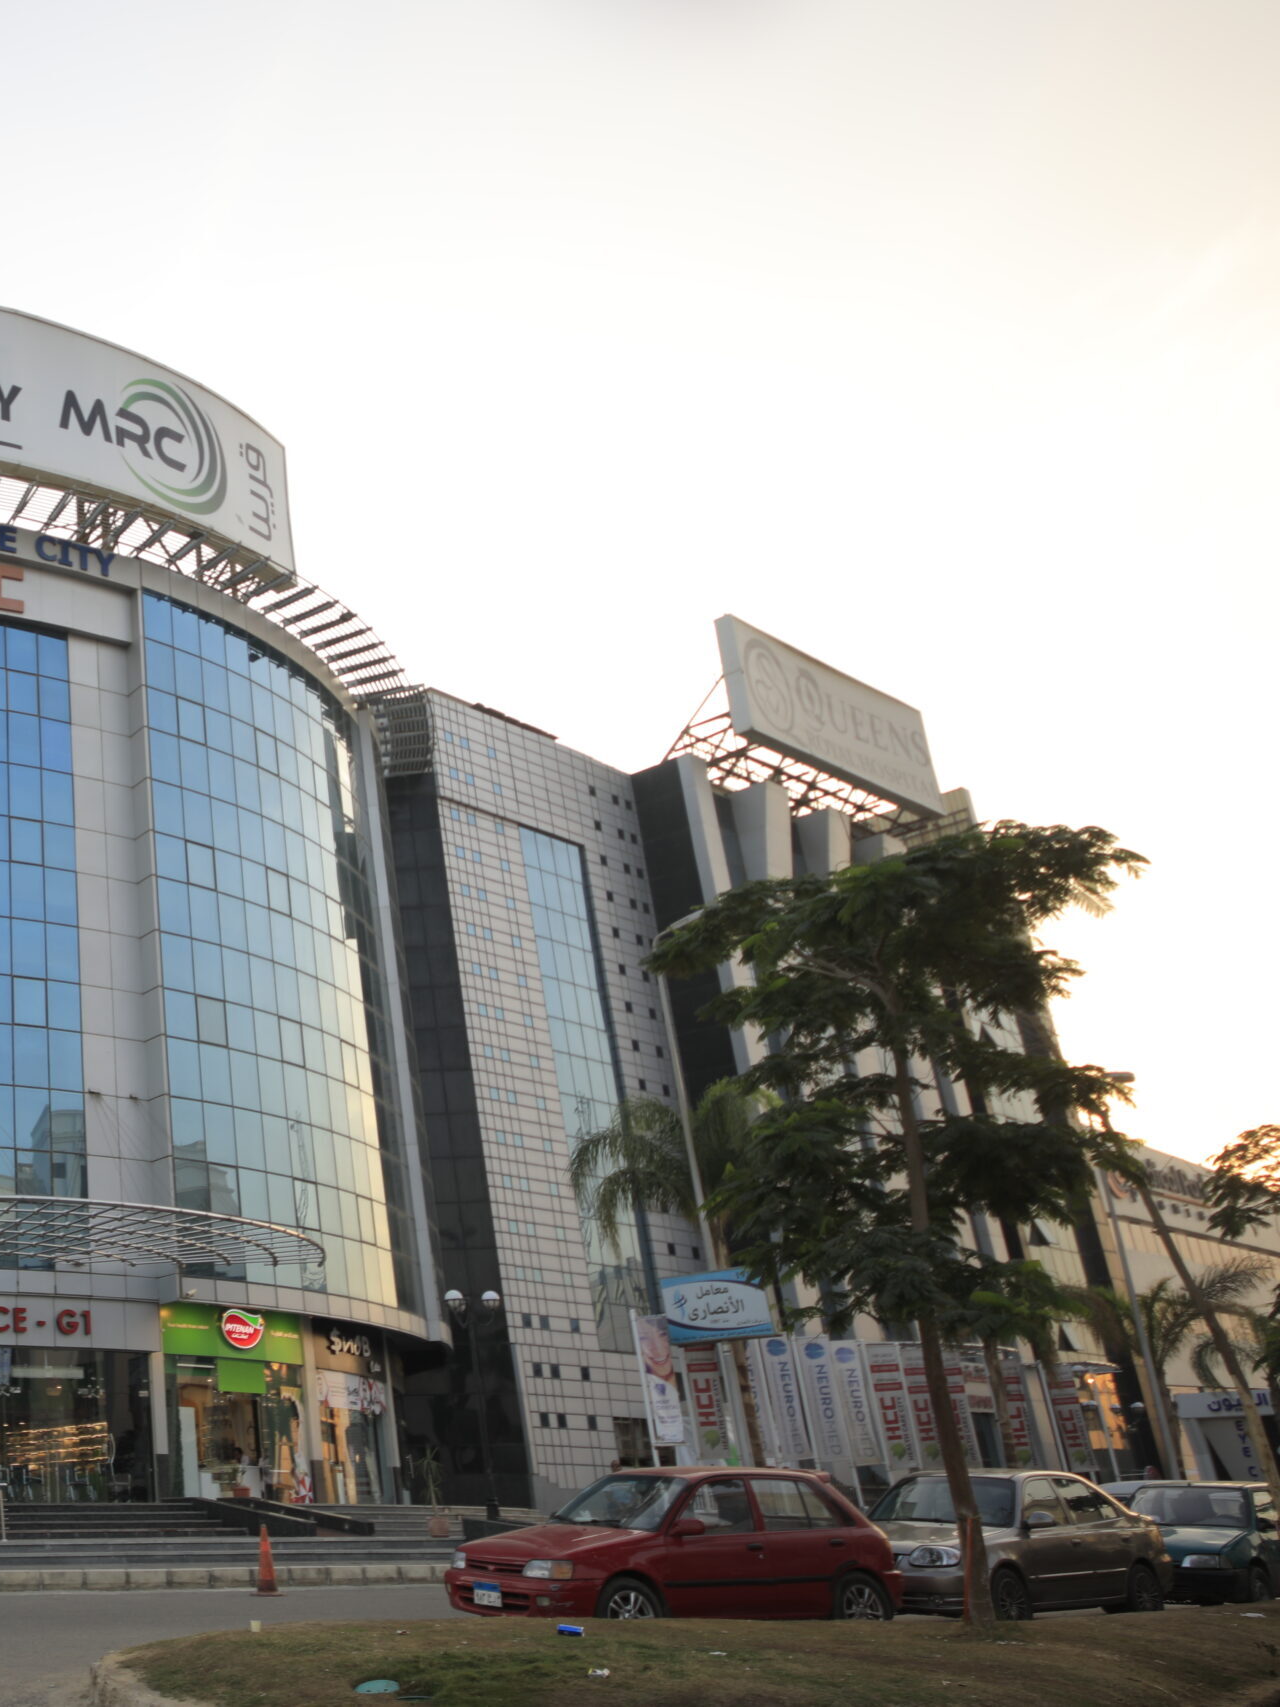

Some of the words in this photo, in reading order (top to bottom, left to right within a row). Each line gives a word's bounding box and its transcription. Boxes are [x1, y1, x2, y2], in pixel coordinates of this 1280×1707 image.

[58, 389, 187, 473] MRC
[35, 534, 117, 577] CITY
[795, 666, 931, 768] QUEENS
[696, 1284, 729, 1300] معامل
[55, 1309, 92, 1336] G1
[693, 1378, 717, 1427] HCC
[814, 1364, 842, 1456] NEUROMED
[879, 1396, 902, 1441] HCC
[913, 1399, 935, 1442] HCC
[1207, 1392, 1270, 1412] اليون
